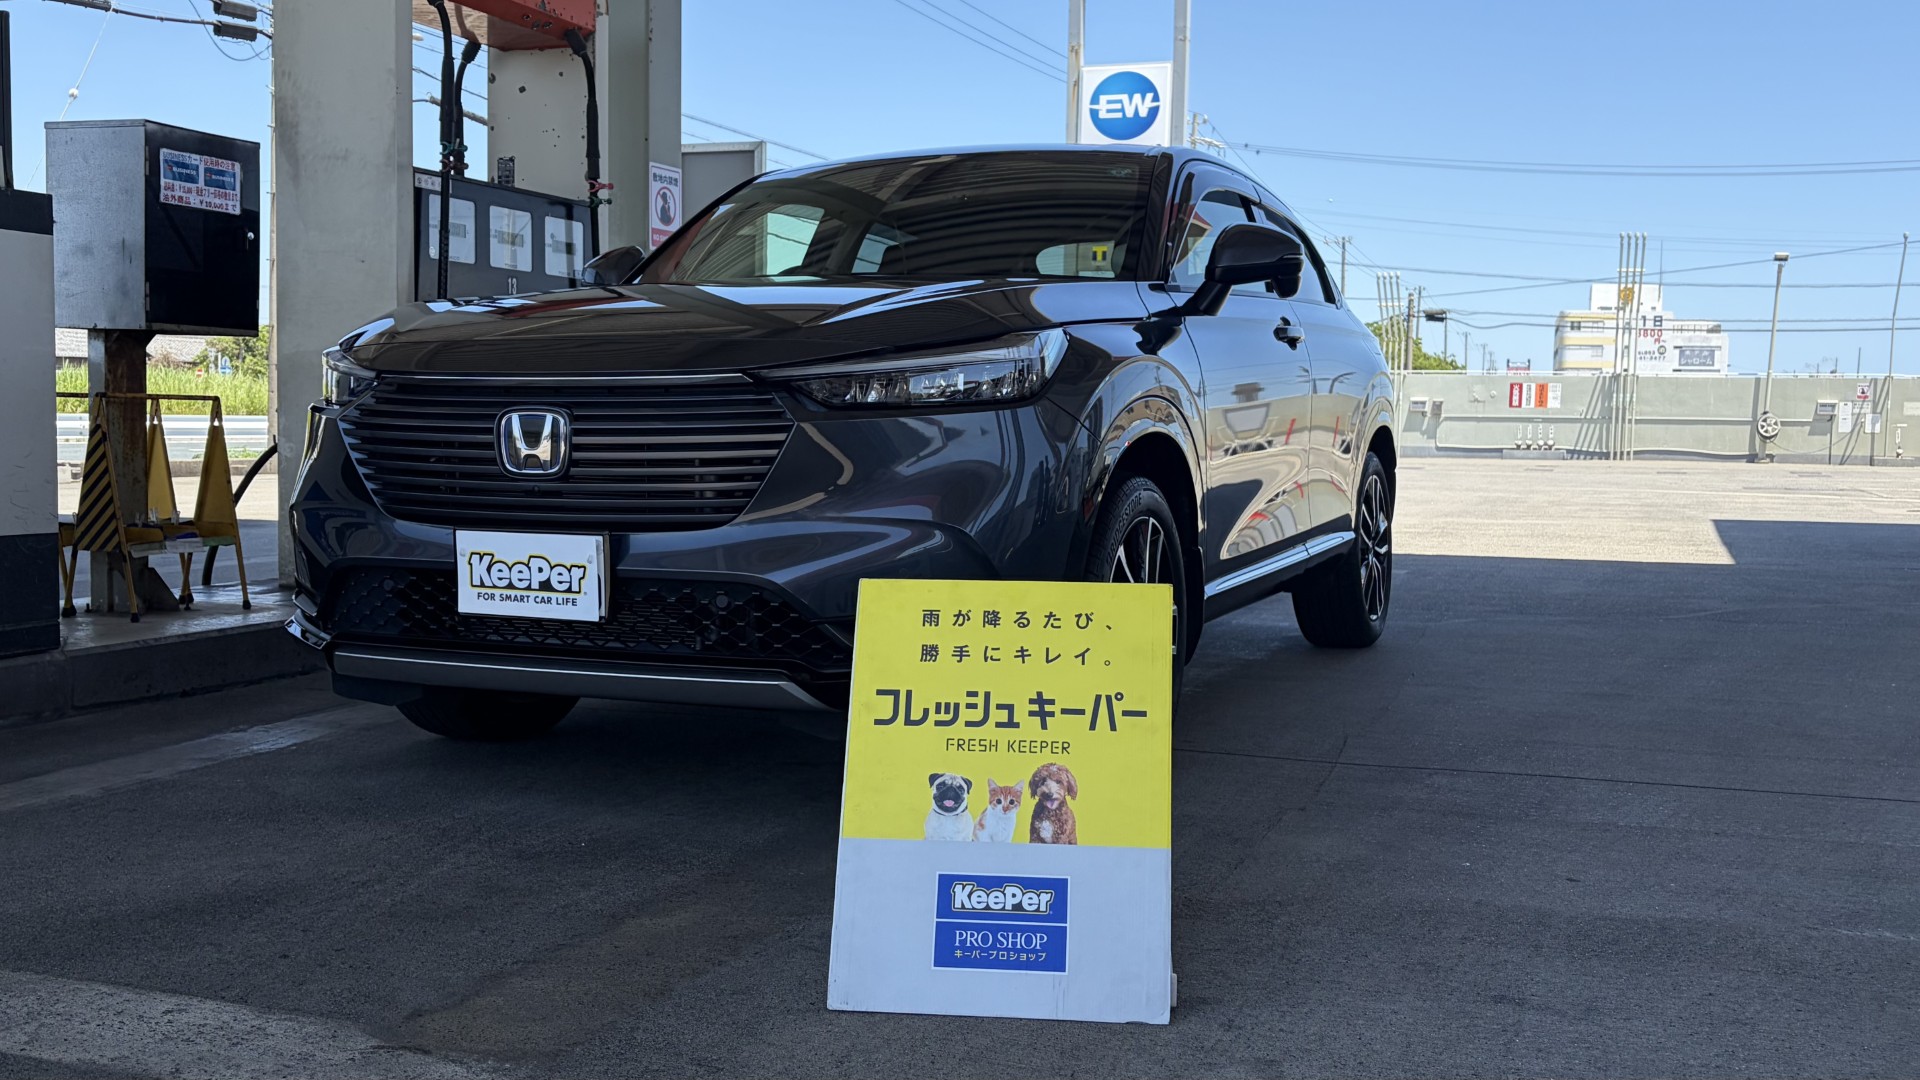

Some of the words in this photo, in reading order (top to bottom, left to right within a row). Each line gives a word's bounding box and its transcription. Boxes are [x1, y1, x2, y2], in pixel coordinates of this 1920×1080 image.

[1098, 92, 1154, 118] EW
[508, 277, 517, 295] 13
[468, 552, 588, 594] KeePer
[477, 592, 496, 601] FOR
[499, 593, 531, 604] SMART
[533, 595, 553, 605] CAR
[555, 596, 578, 606] LIFE
[921, 608, 1113, 631] 雨が降るたび、
[919, 643, 1112, 667] 勝手にキレイ。
[873, 688, 1148, 732] フレッシュキーパー
[945, 737, 999, 753] FRESH
[1007, 739, 1071, 755] KEEPER
[951, 881, 1055, 915] KeePer
[954, 930, 993, 948] PRO
[996, 931, 1048, 950] SHOP
